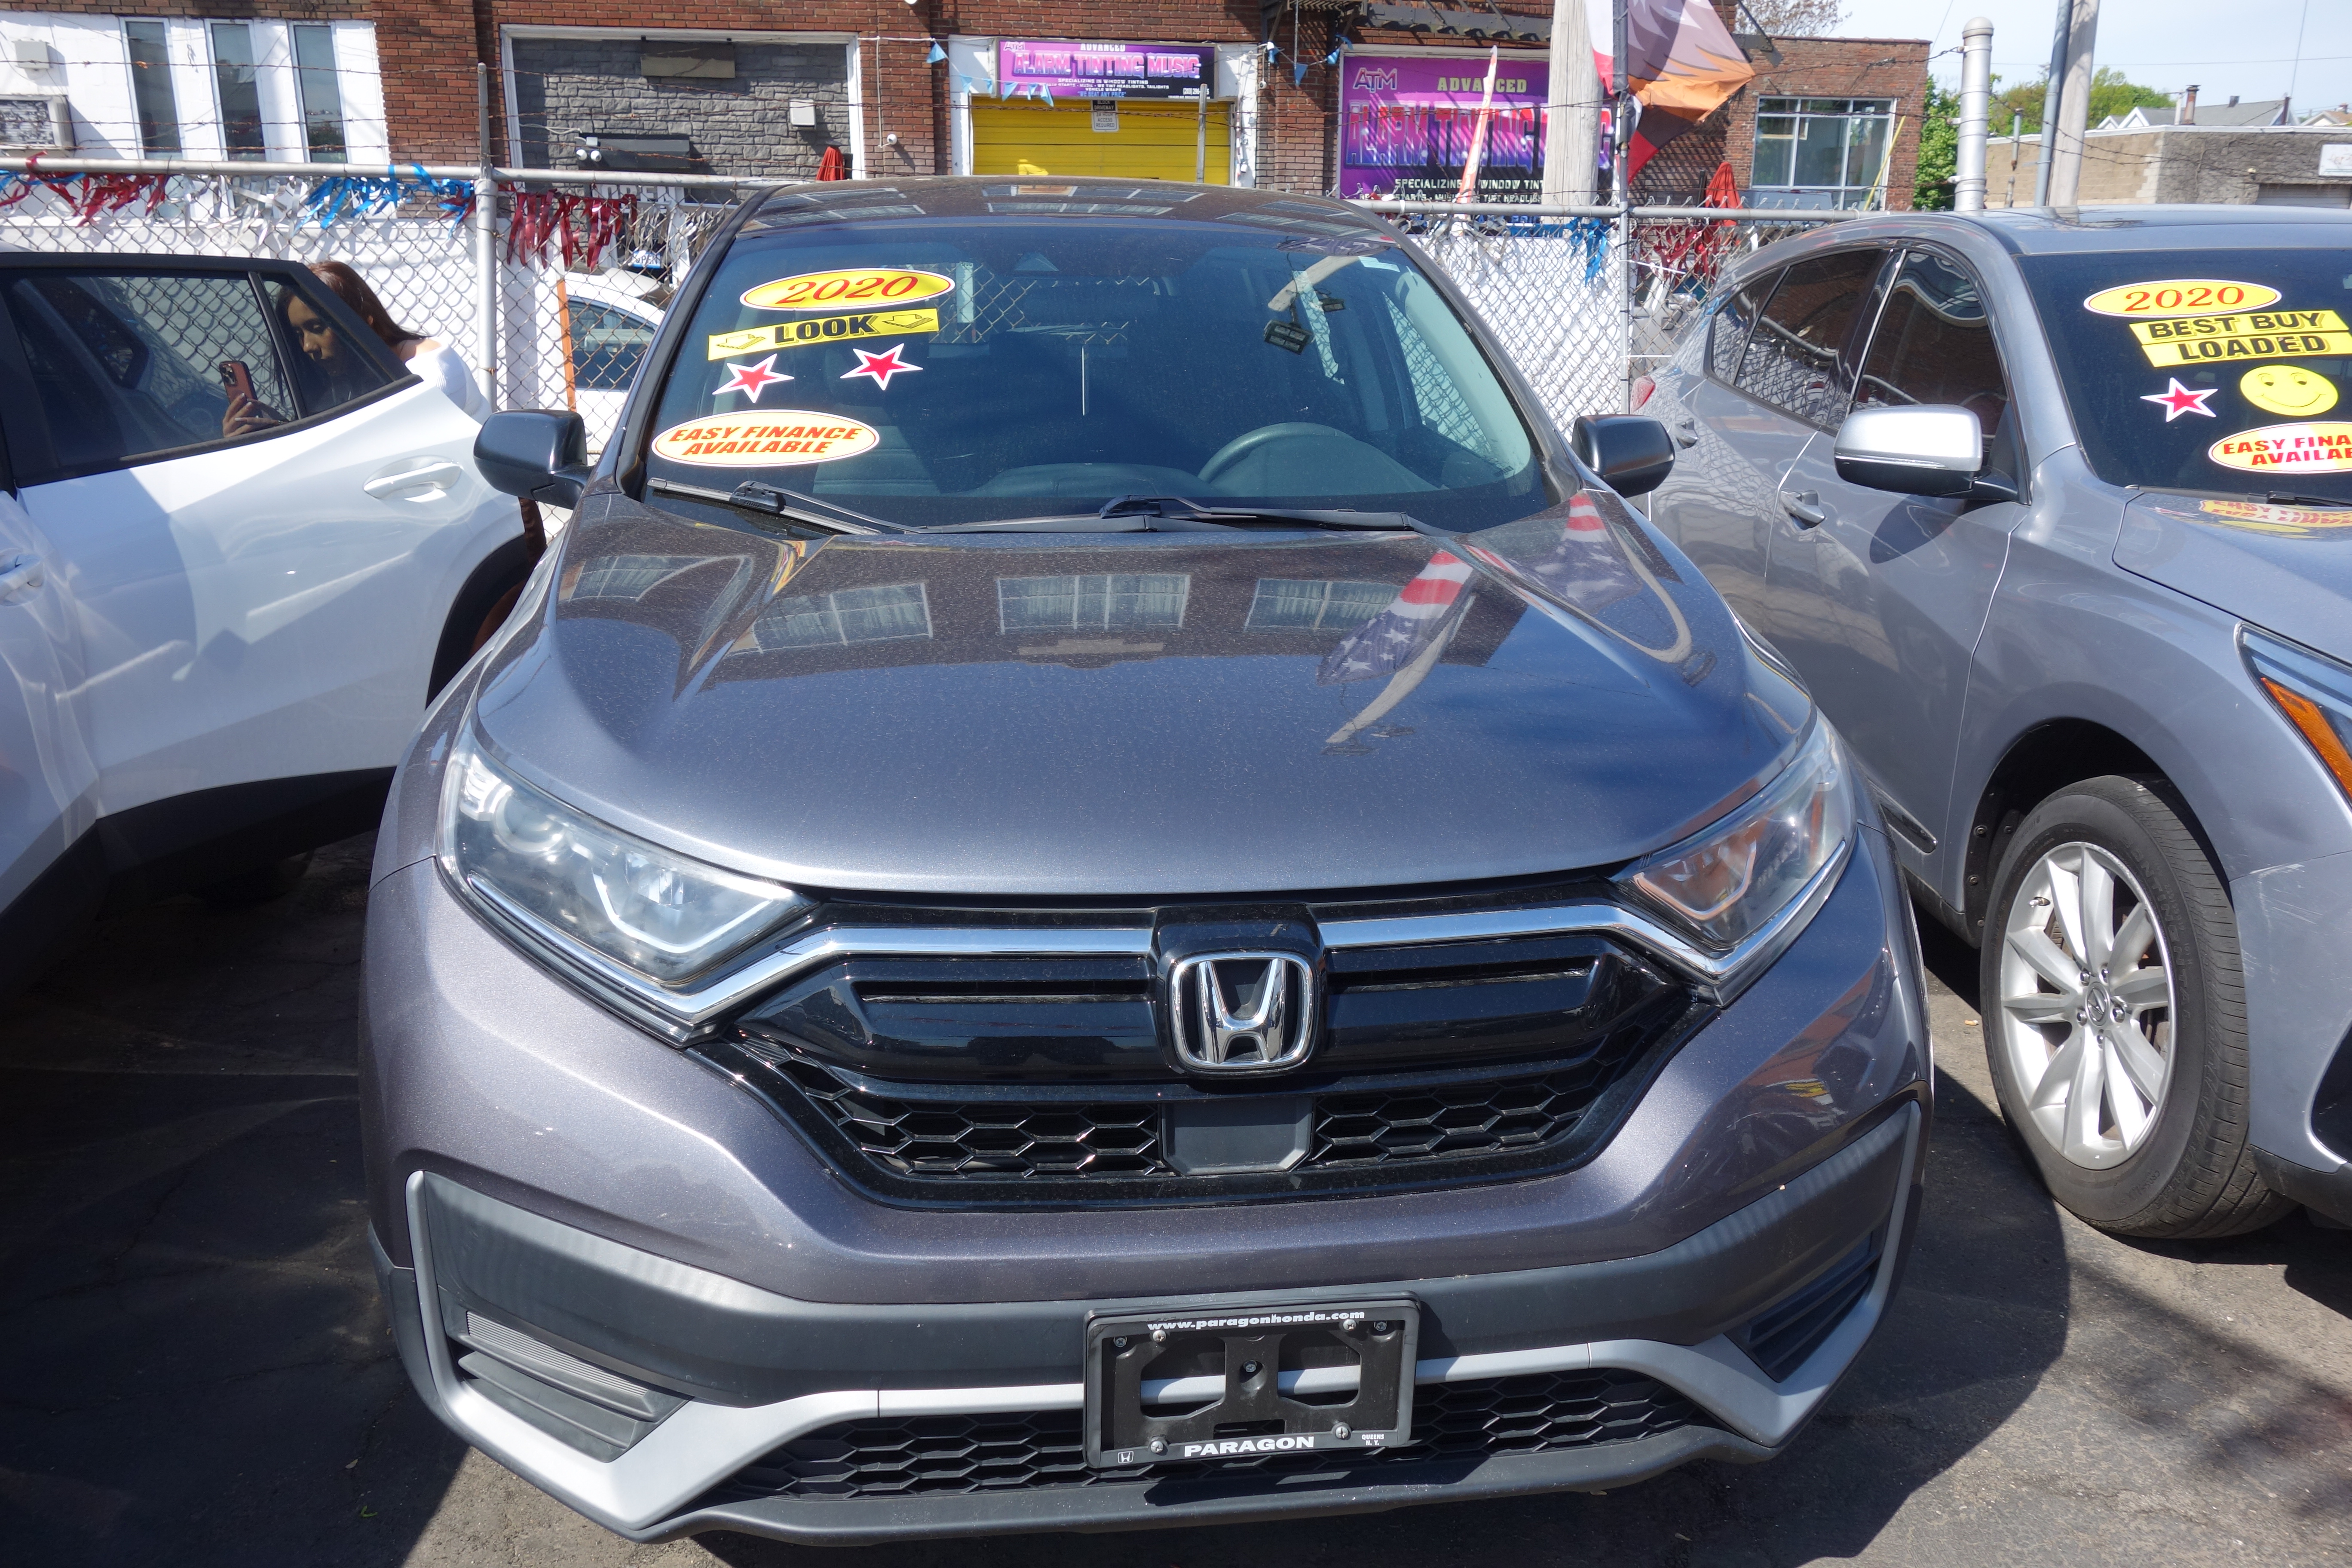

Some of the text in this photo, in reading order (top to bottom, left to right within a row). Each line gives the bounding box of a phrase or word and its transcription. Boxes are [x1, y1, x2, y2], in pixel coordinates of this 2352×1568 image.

[1003, 41, 1026, 52] ATM
[1080, 43, 1126, 52] ADVANCED
[1014, 51, 1201, 79] ALARM TINTING MUSIC
[1353, 67, 1398, 92] ATM
[1437, 77, 1528, 93] ADVACED
[1345, 100, 1430, 167] ALARM
[1395, 178, 1462, 189] SPECIALIZING
[1480, 179, 1521, 189] WINDOW
[775, 276, 919, 305] 2020
[2124, 287, 2245, 312] 2020
[775, 315, 878, 346] LOOK
[2148, 312, 2325, 340] BEST BUY
[2177, 334, 2331, 361] LOADED
[668, 426, 862, 441] EASY FINANCE
[2223, 434, 2352, 455] EASY FINA
[681, 441, 833, 455] AVAILABLE
[1147, 1311, 1365, 1332] www.paragonhonda.com
[1184, 1435, 1314, 1457] PARAGON
